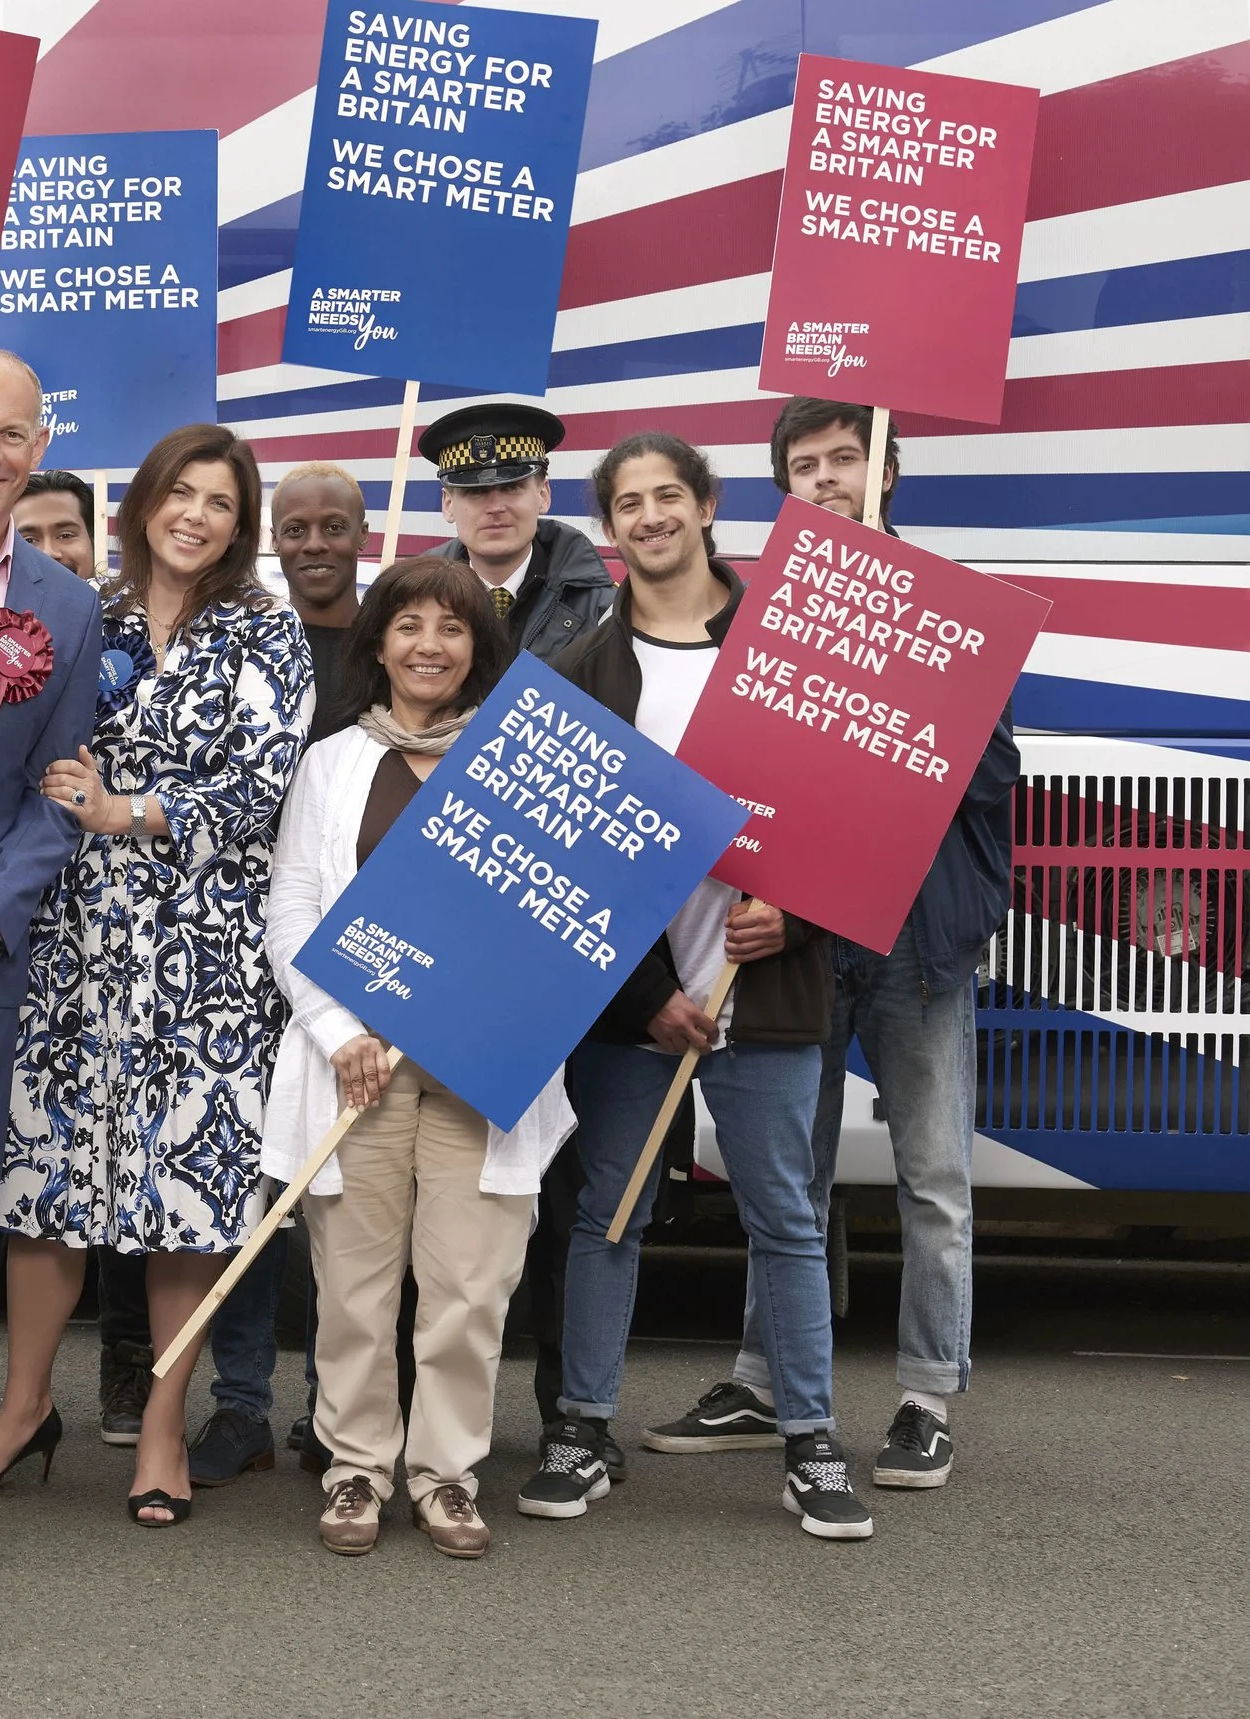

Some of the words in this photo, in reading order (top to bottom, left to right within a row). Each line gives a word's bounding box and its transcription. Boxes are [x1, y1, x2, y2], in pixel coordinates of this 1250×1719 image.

[348, 11, 470, 48] SAVING
[345, 38, 476, 76] ENERGY
[485, 57, 552, 88] FOR
[338, 93, 466, 133] BRITAIN
[340, 66, 362, 90] A
[373, 71, 526, 113] SMARTER
[818, 79, 925, 113] SAVING
[811, 127, 832, 148] A
[841, 131, 975, 169] SMARTER
[816, 103, 931, 138] ENERGY
[939, 121, 997, 148] FOR
[13, 155, 107, 178] AVING
[333, 139, 384, 168] WE
[394, 149, 503, 186] CHOSE
[511, 166, 535, 191] A
[810, 150, 924, 186] BRITAIN
[4, 206, 20, 226] A
[29, 201, 162, 225] SMARTER
[8, 179, 115, 203] ENERGY
[124, 177, 181, 198] FOR
[327, 167, 437, 203] SMART
[446, 184, 554, 222] METER
[806, 190, 852, 216] WE
[860, 199, 957, 232] CHOSE
[964, 215, 984, 236] A
[1, 227, 113, 250] BRITAIN
[801, 215, 899, 247] SMART
[907, 230, 1001, 263] METER
[0, 269, 46, 289] WE
[55, 265, 151, 288] CHOSE
[160, 264, 180, 284] A
[312, 288, 324, 299] A
[327, 288, 401, 302] SMARTER
[0, 291, 96, 313] SMART
[105, 288, 198, 310] METER
[310, 300, 371, 313] BRITAIN
[308, 312, 359, 326] NEEDS
[354, 314, 398, 350] You
[794, 529, 915, 593] SAVING
[770, 582, 792, 608] A
[802, 594, 951, 672] SMARTER
[782, 554, 914, 622] ENERGY
[916, 609, 985, 655] FOR
[760, 605, 888, 675] BRITAIN
[747, 646, 798, 687] WE
[803, 674, 910, 735] CHOSE
[912, 723, 935, 749] A
[517, 688, 627, 774] SAVING
[731, 673, 840, 732] SMART
[843, 720, 949, 783] METER
[465, 754, 583, 849] BRITAIN
[481, 736, 506, 762] A
[510, 753, 644, 861] SMARTER
[499, 709, 619, 800] ENERGY
[615, 794, 681, 851] FOR
[442, 791, 491, 840] WE
[491, 834, 590, 914] CHOSE
[586, 908, 611, 935] A
[421, 816, 521, 894] SMART
[518, 888, 616, 971] METER
[343, 924, 402, 964] BRITAIN
[352, 916, 364, 929] A
[365, 923, 435, 969] SMARTER
[336, 935, 385, 969] NEEDS
[365, 961, 412, 1000] You
